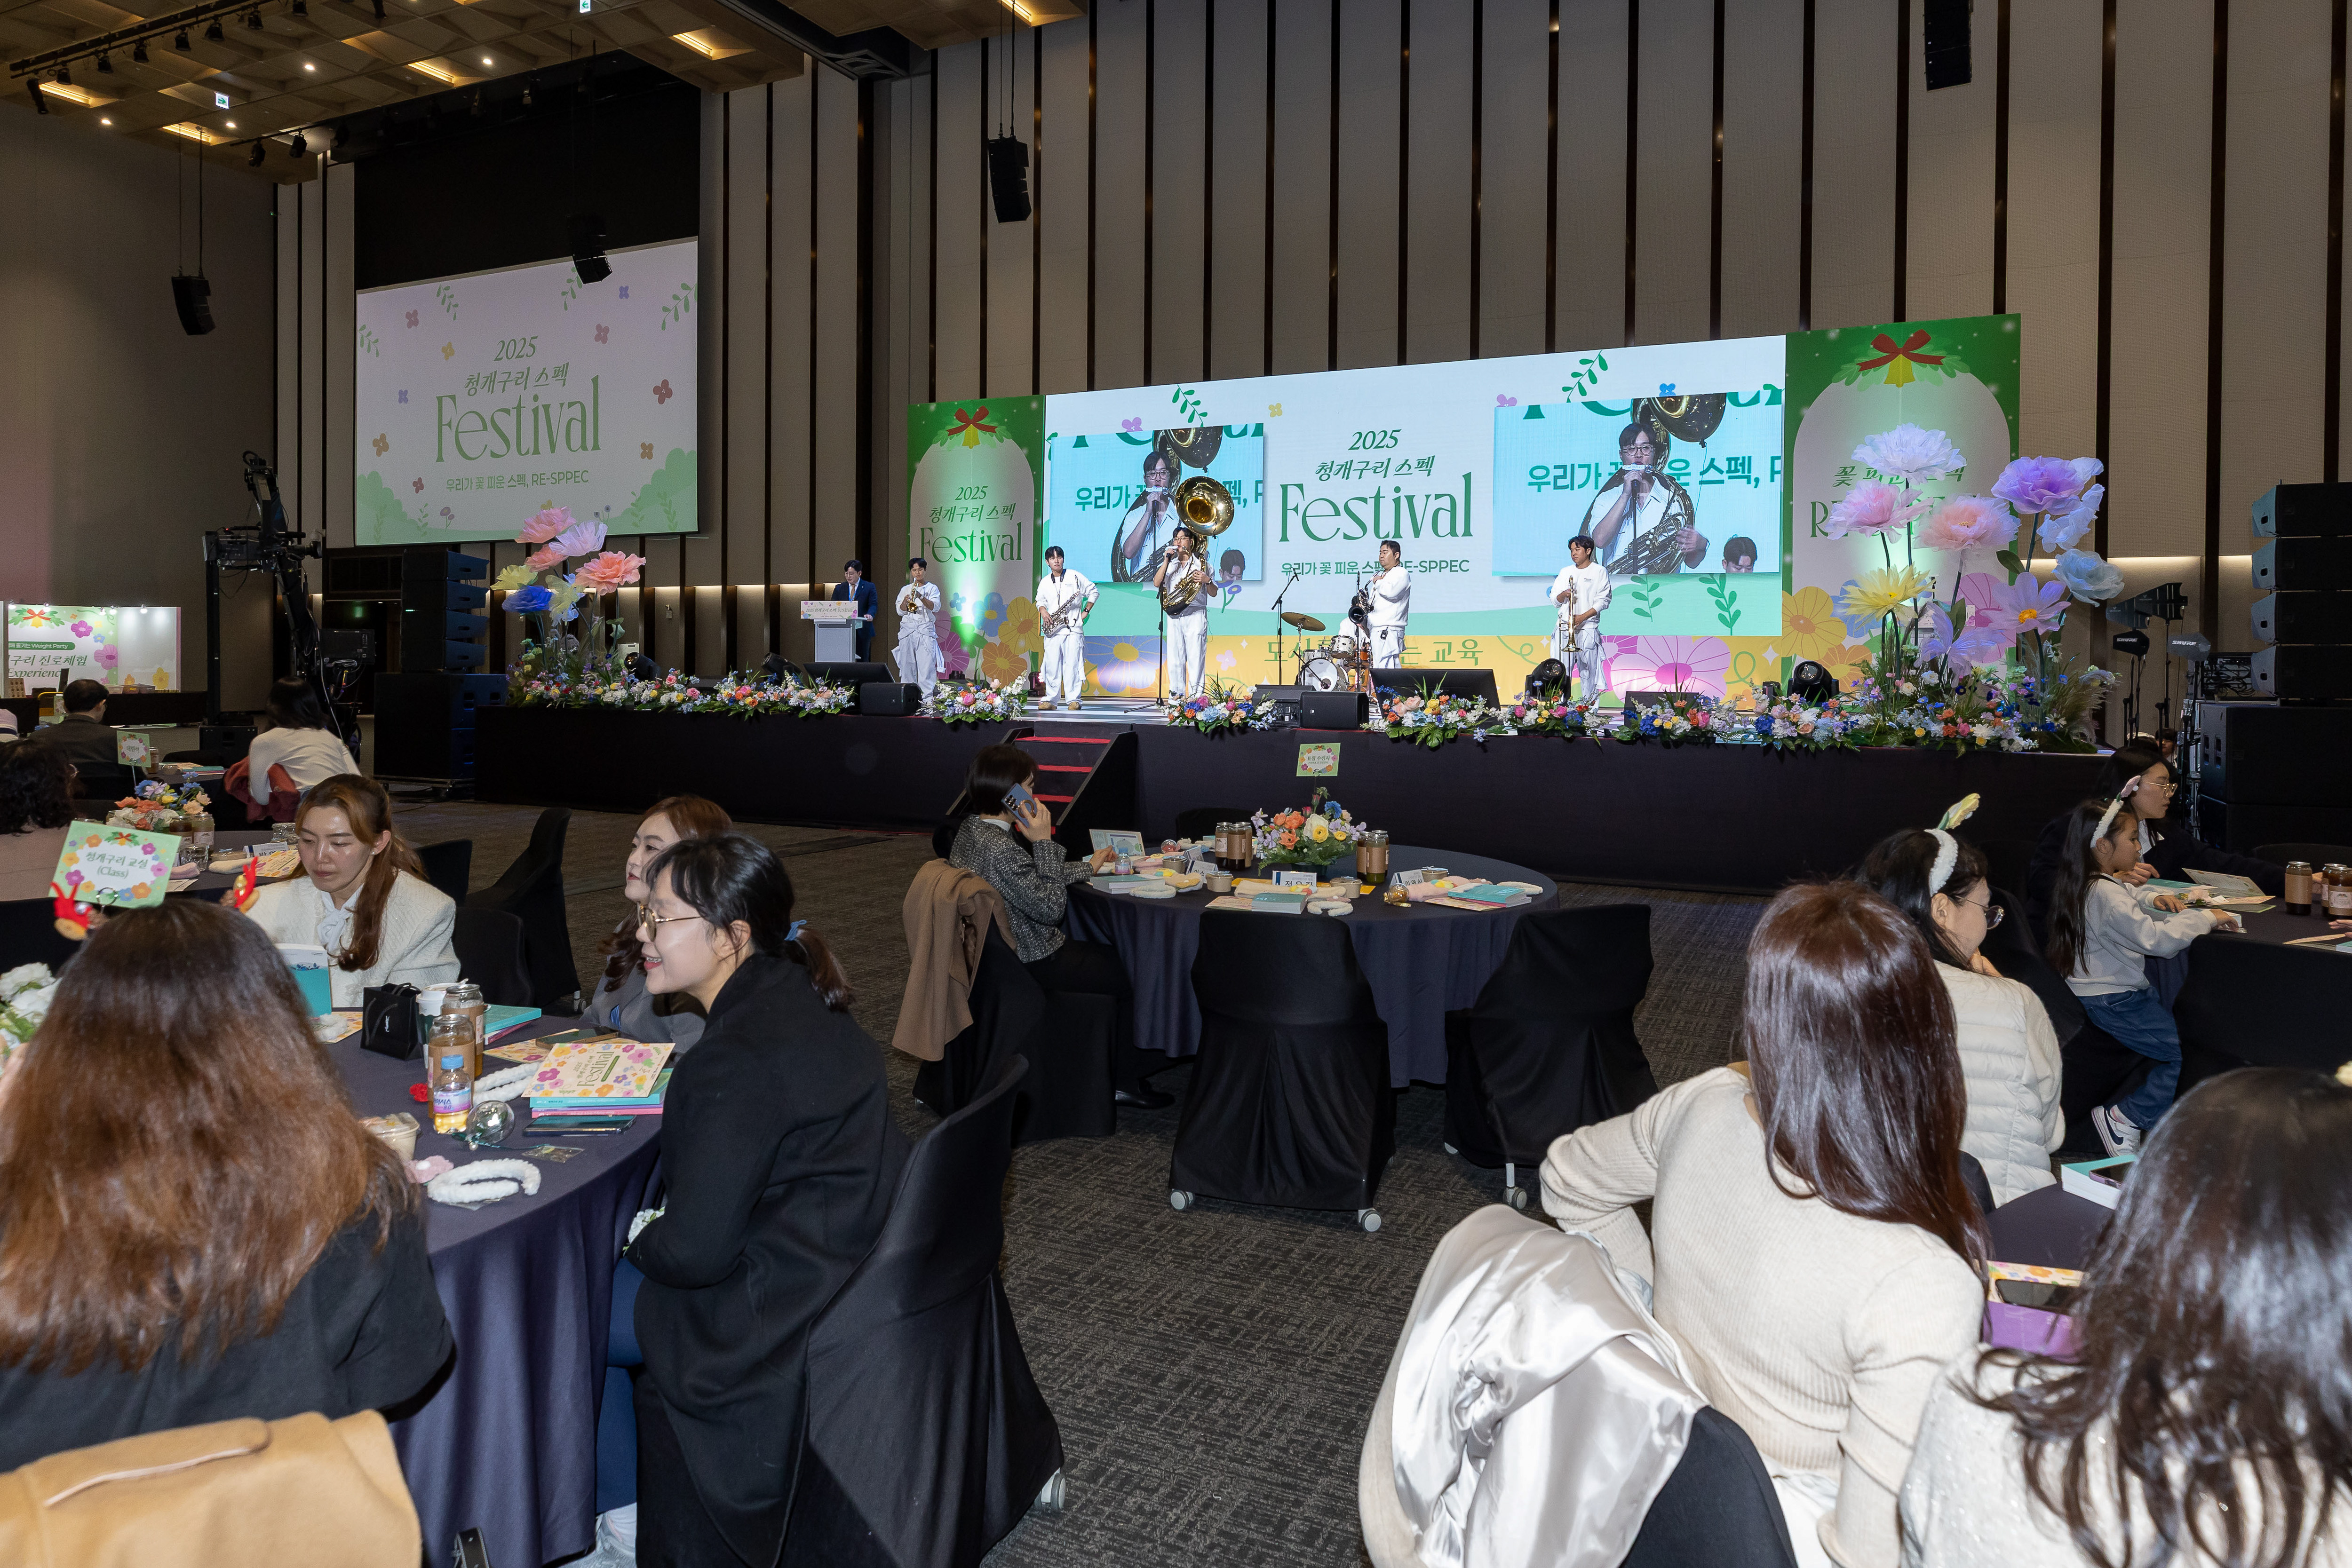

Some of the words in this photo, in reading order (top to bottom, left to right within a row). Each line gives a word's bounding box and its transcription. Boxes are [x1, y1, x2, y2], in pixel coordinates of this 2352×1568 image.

[493, 335, 539, 361] 2025
[464, 366, 530, 396] 청개구리
[533, 362, 569, 387] 스펙
[436, 374, 601, 463] Festival
[1348, 429, 1402, 450] 2025
[1315, 458, 1391, 481] 청개구리
[1393, 455, 1435, 476] 스펙
[1528, 462, 1602, 492] 우리가
[1699, 456, 1760, 489] 스펙,
[1832, 466, 1857, 487] 꽃
[446, 478, 473, 492] 우리가
[476, 476, 484, 490] 꽃
[487, 475, 505, 489] 피운
[508, 474, 528, 489] 스펙,
[532, 470, 588, 486] RE-SPPEC
[954, 486, 988, 500] 2025
[1075, 485, 1131, 511] 우리가
[929, 505, 984, 523] 청개구리
[986, 503, 1016, 520] 스펙
[1279, 471, 1473, 542] Festival
[920, 522, 1023, 563] Festival
[1281, 562, 1317, 576] 우리가
[1319, 562, 1331, 575] 꽃
[1335, 562, 1359, 575] 피운
[8, 655, 36, 666] 구리
[39, 655, 87, 666] 진로체험
[1430, 639, 1483, 666] 교육
[8, 668, 61, 678] Experienc
[86, 852, 126, 866] 청개구리
[127, 858, 148, 869] 교실
[97, 866, 129, 879] (Class)
[572, 1062, 583, 1072] 2025
[577, 1052, 614, 1086] Festival
